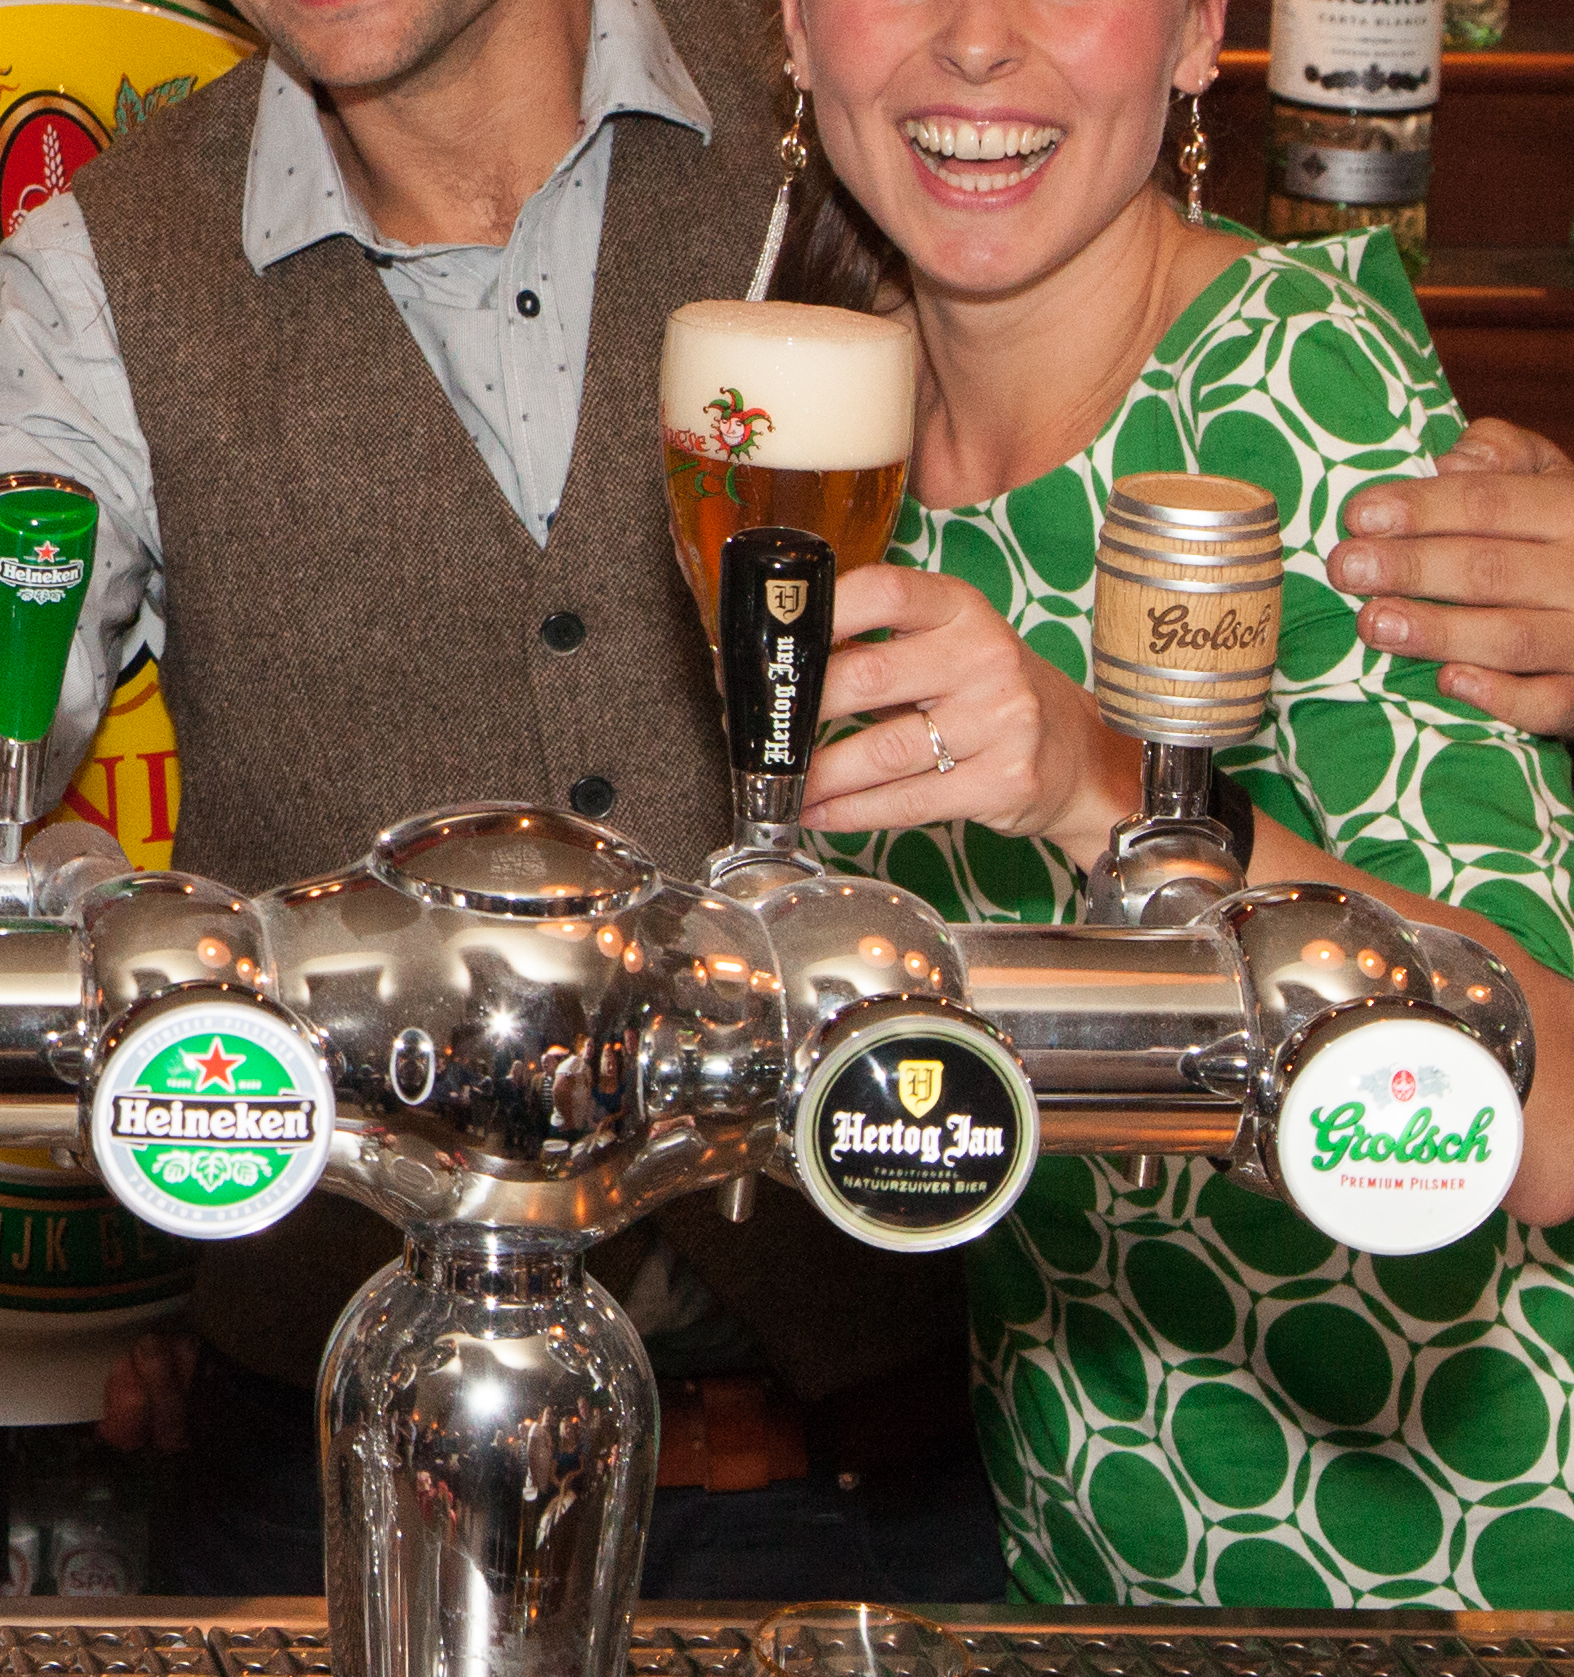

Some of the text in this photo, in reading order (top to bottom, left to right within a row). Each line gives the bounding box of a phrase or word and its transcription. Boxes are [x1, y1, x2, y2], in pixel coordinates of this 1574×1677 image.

[2, 563, 80, 584] Heineken
[1147, 603, 1272, 655] Grolsch
[763, 635, 800, 766] Hertog Jan
[117, 1099, 310, 1139] Heineken
[830, 1110, 1005, 1169] Hertog Jan
[1309, 1101, 1495, 1171] Grolsch
